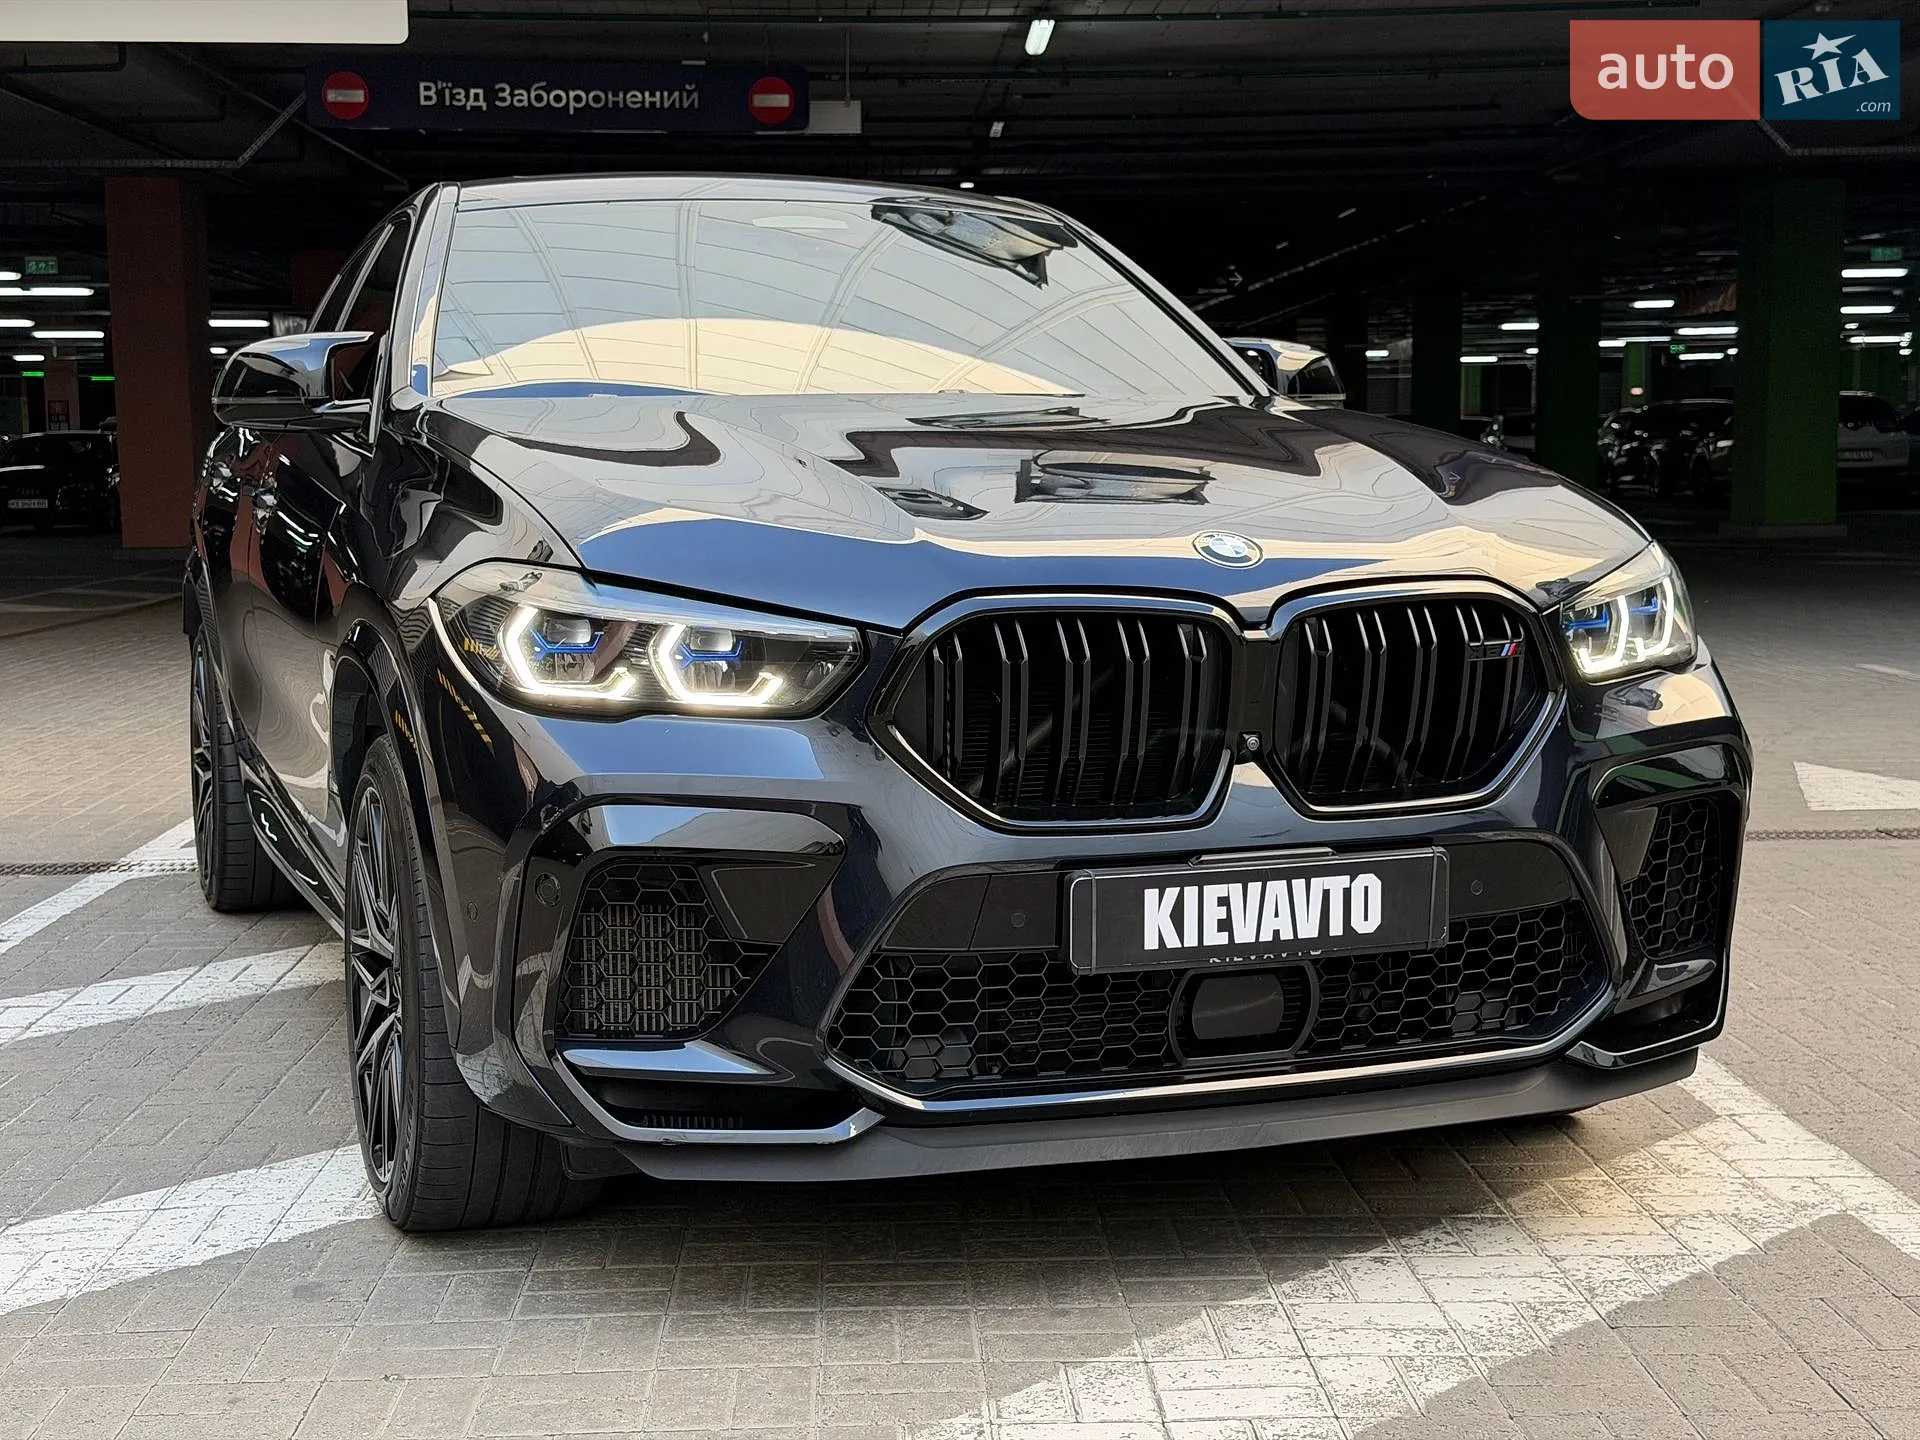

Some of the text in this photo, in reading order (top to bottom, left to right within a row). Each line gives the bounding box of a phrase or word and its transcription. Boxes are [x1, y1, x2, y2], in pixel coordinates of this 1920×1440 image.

[419, 81, 699, 115] В'їзд Заборонений
[1143, 872, 1382, 951] KIEVAVTO
